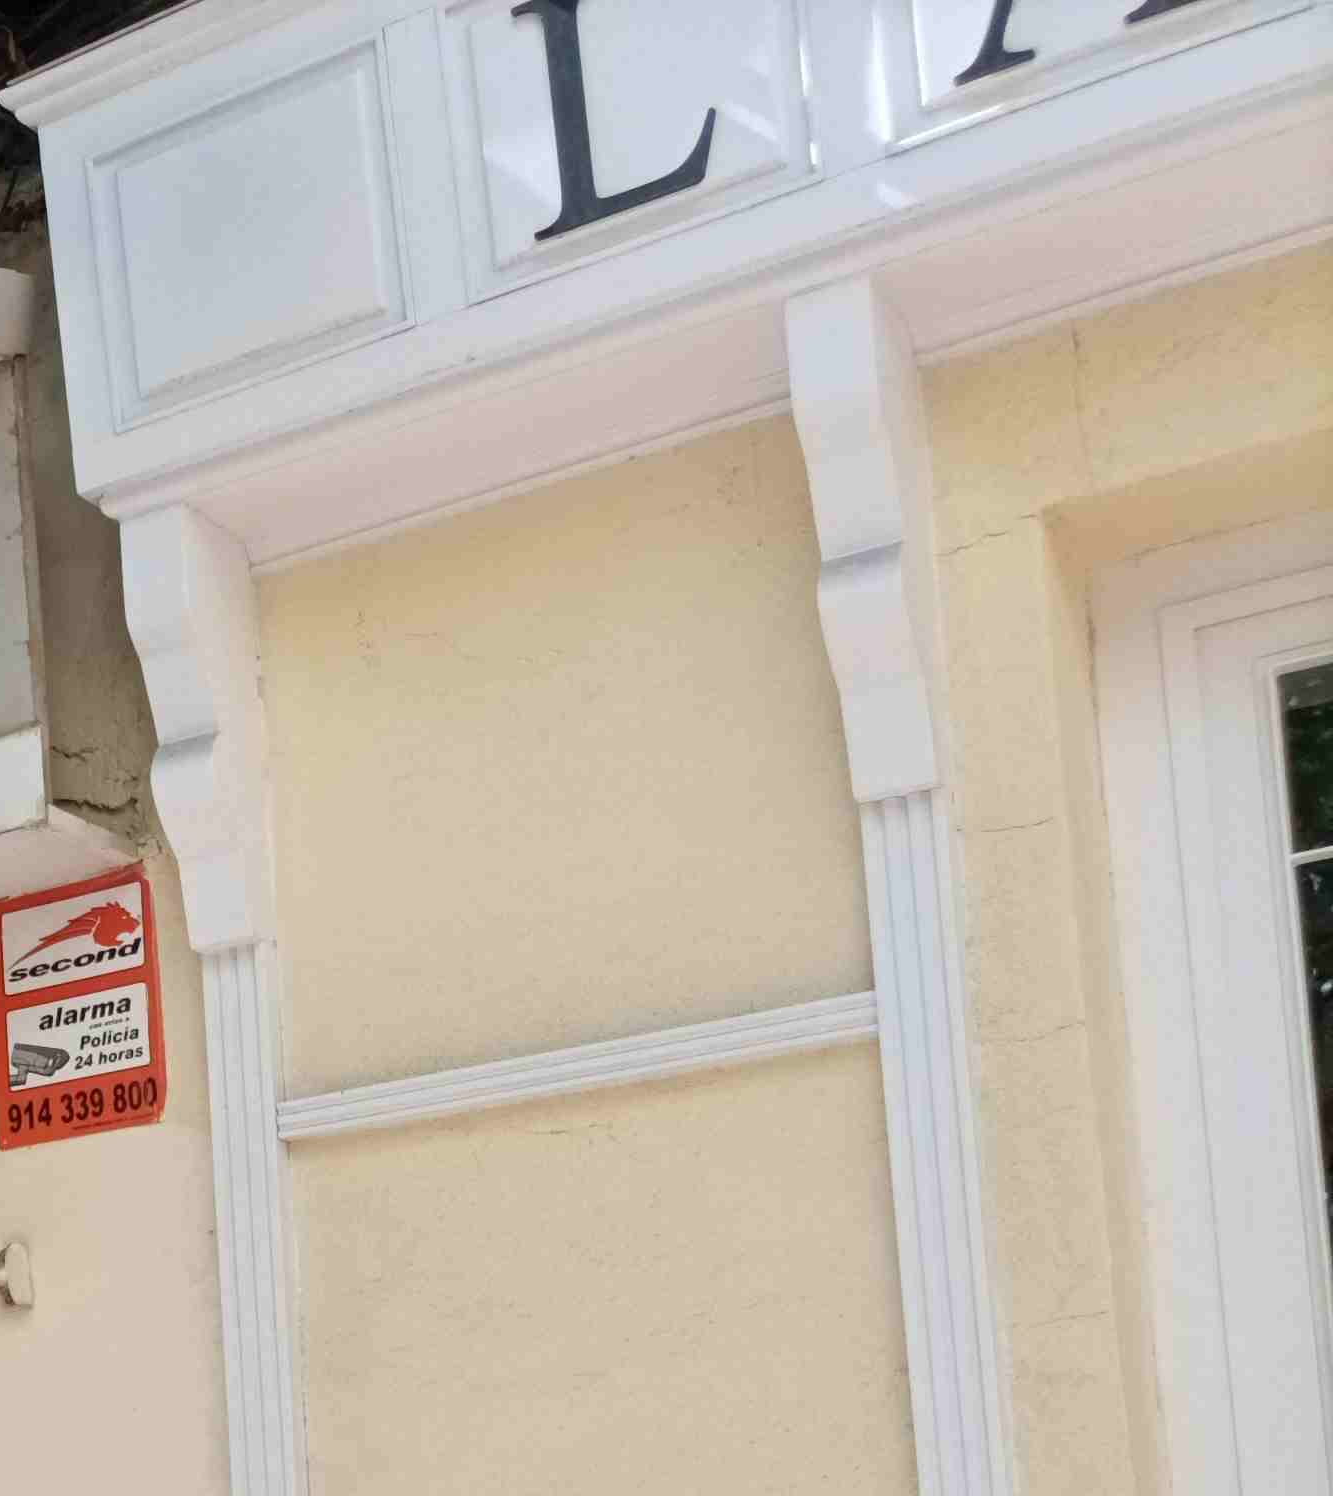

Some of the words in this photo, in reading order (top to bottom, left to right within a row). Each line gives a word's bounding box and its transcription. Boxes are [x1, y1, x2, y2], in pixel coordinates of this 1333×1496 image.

[7, 937, 142, 983] second
[38, 997, 132, 1031] alarma
[74, 1053, 93, 1070] 24
[98, 1046, 144, 1065] horas
[8, 1098, 52, 1133] 914
[60, 1088, 104, 1124] 339
[113, 1077, 157, 1114] 800
